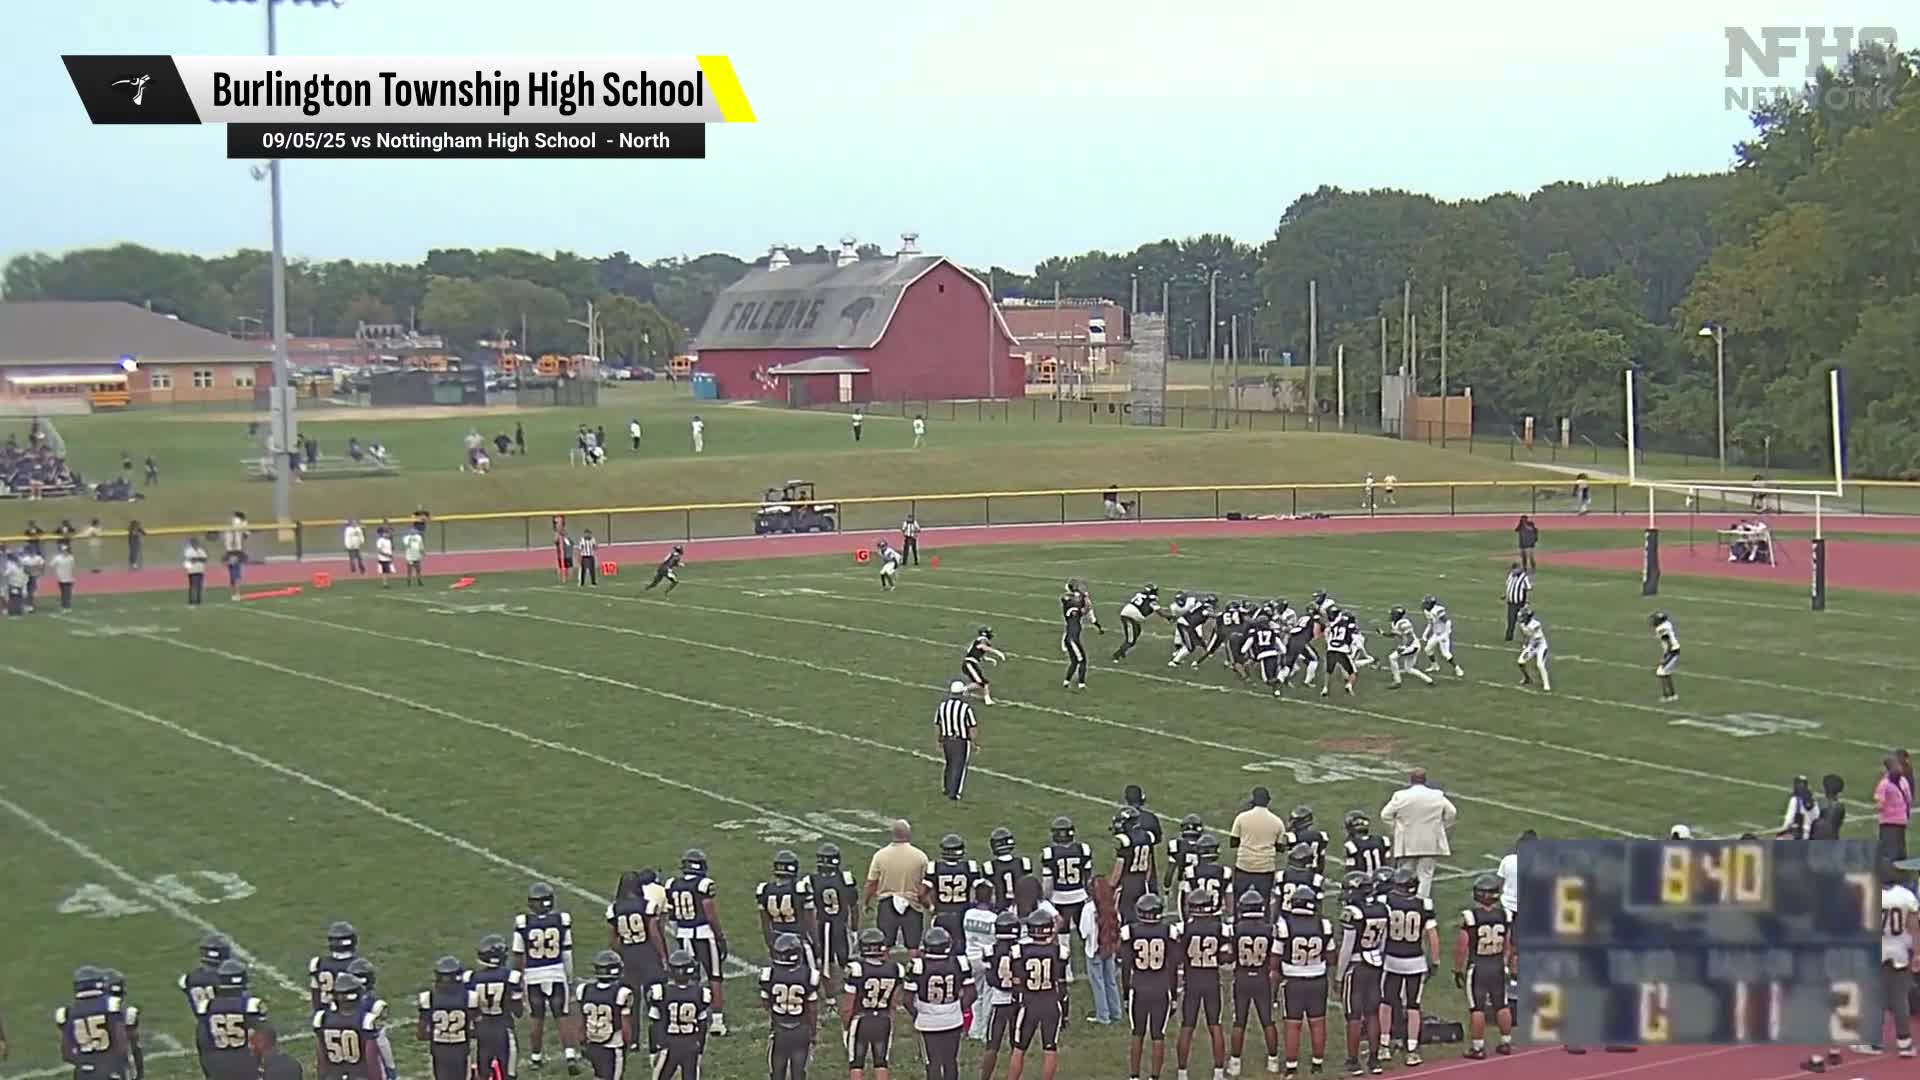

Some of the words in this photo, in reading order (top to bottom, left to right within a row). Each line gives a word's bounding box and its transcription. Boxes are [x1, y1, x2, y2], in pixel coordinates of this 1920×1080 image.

[720, 298, 826, 332] FALCONS
[859, 550, 868, 560] G
[1003, 872, 1014, 900] 1
[1056, 857, 1082, 885] 15
[822, 888, 841, 915] 9
[938, 874, 969, 903] 52
[671, 890, 696, 921] 10
[766, 893, 796, 923] 44
[616, 912, 647, 945] 49
[1388, 911, 1421, 943] 80
[1476, 925, 1506, 956] 26
[528, 927, 560, 960] 33
[1133, 937, 1165, 971] 38
[1187, 935, 1218, 969] 42
[927, 974, 954, 1004] 61
[996, 957, 1013, 989] 4
[1025, 958, 1052, 990] 31
[772, 983, 806, 1015] 36
[862, 977, 896, 1009] 37
[73, 1014, 111, 1053] 45
[209, 1012, 247, 1048] 65
[432, 1009, 467, 1043] 22
[667, 1002, 698, 1034] 19
[323, 1028, 361, 1064] 50
